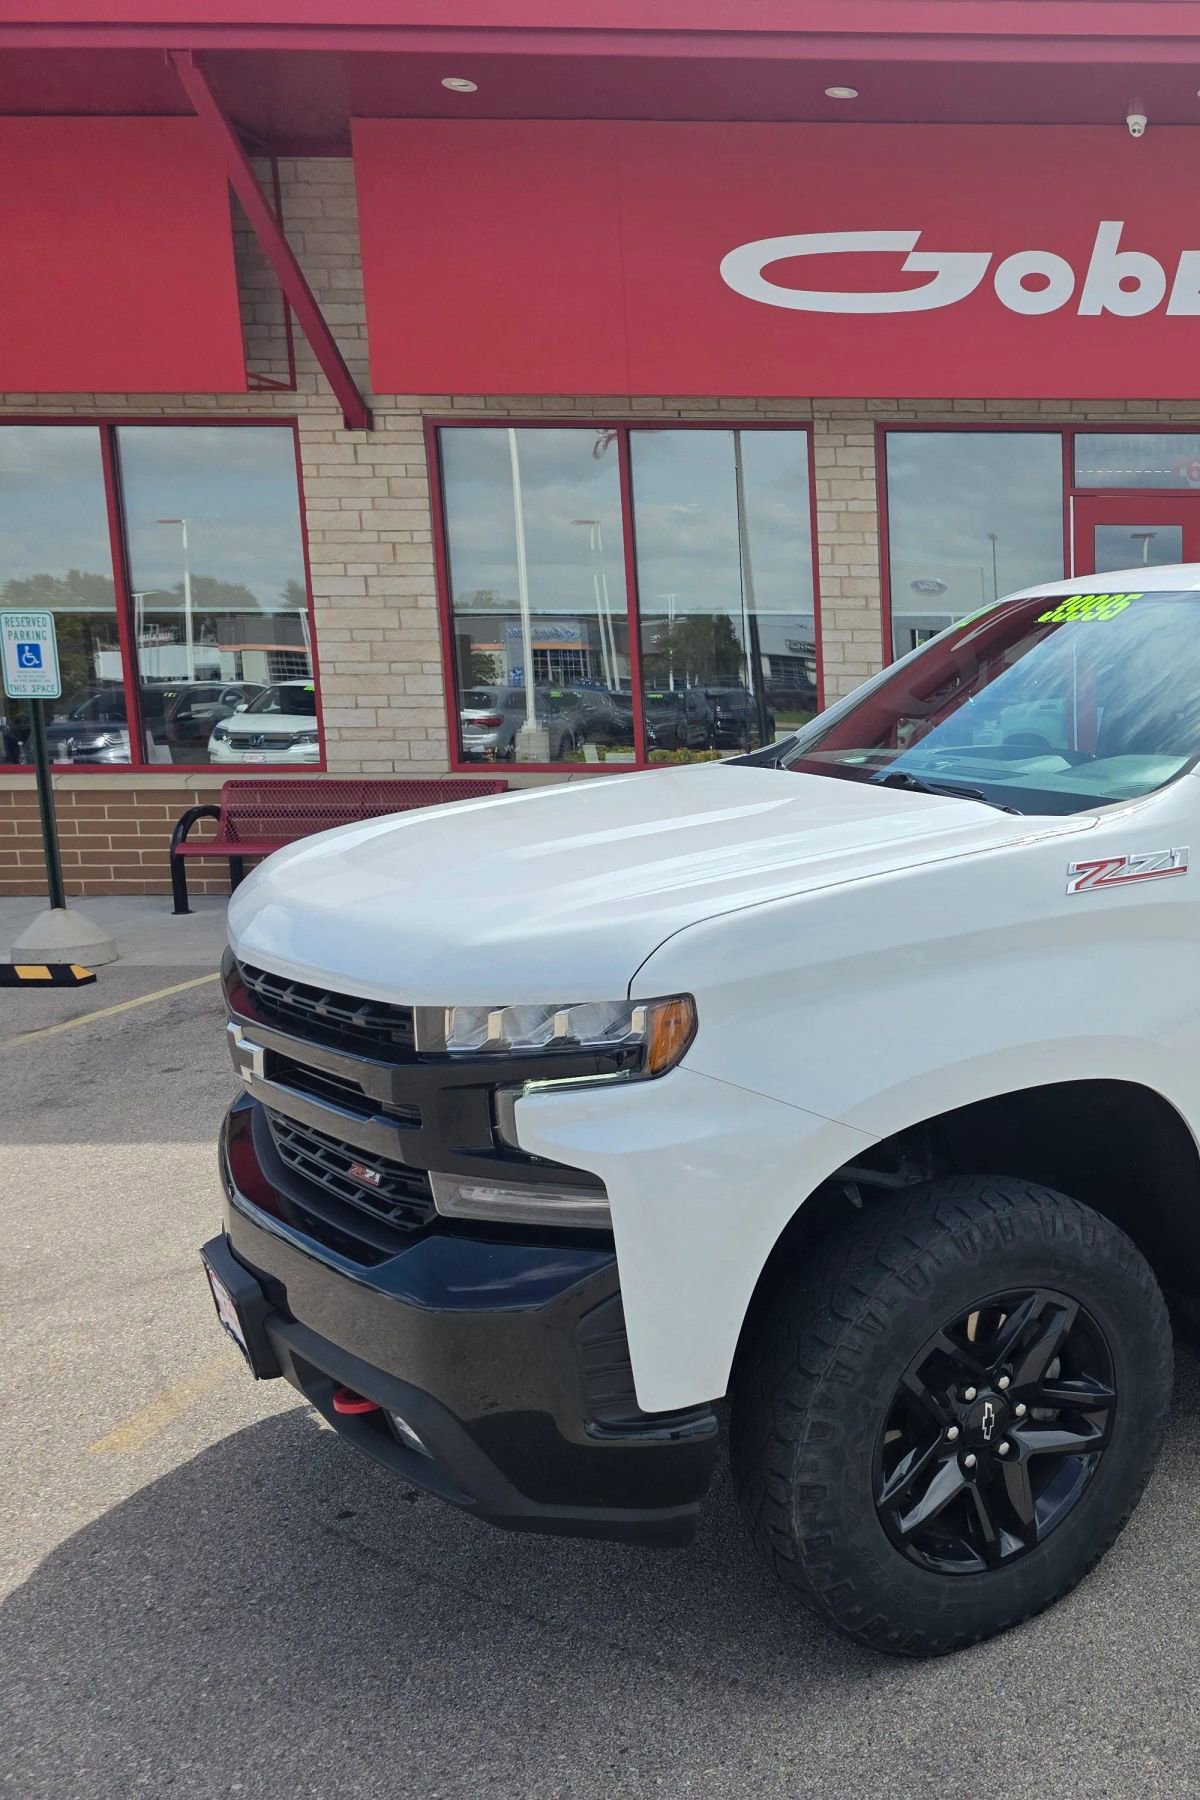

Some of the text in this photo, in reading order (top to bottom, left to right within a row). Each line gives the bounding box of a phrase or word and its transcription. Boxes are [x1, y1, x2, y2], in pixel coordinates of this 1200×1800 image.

[5, 616, 48, 628] RESERVED
[8, 630, 48, 641] PARKING
[9, 684, 57, 694] THIS SPACE
[1066, 846, 1190, 895] Z71
